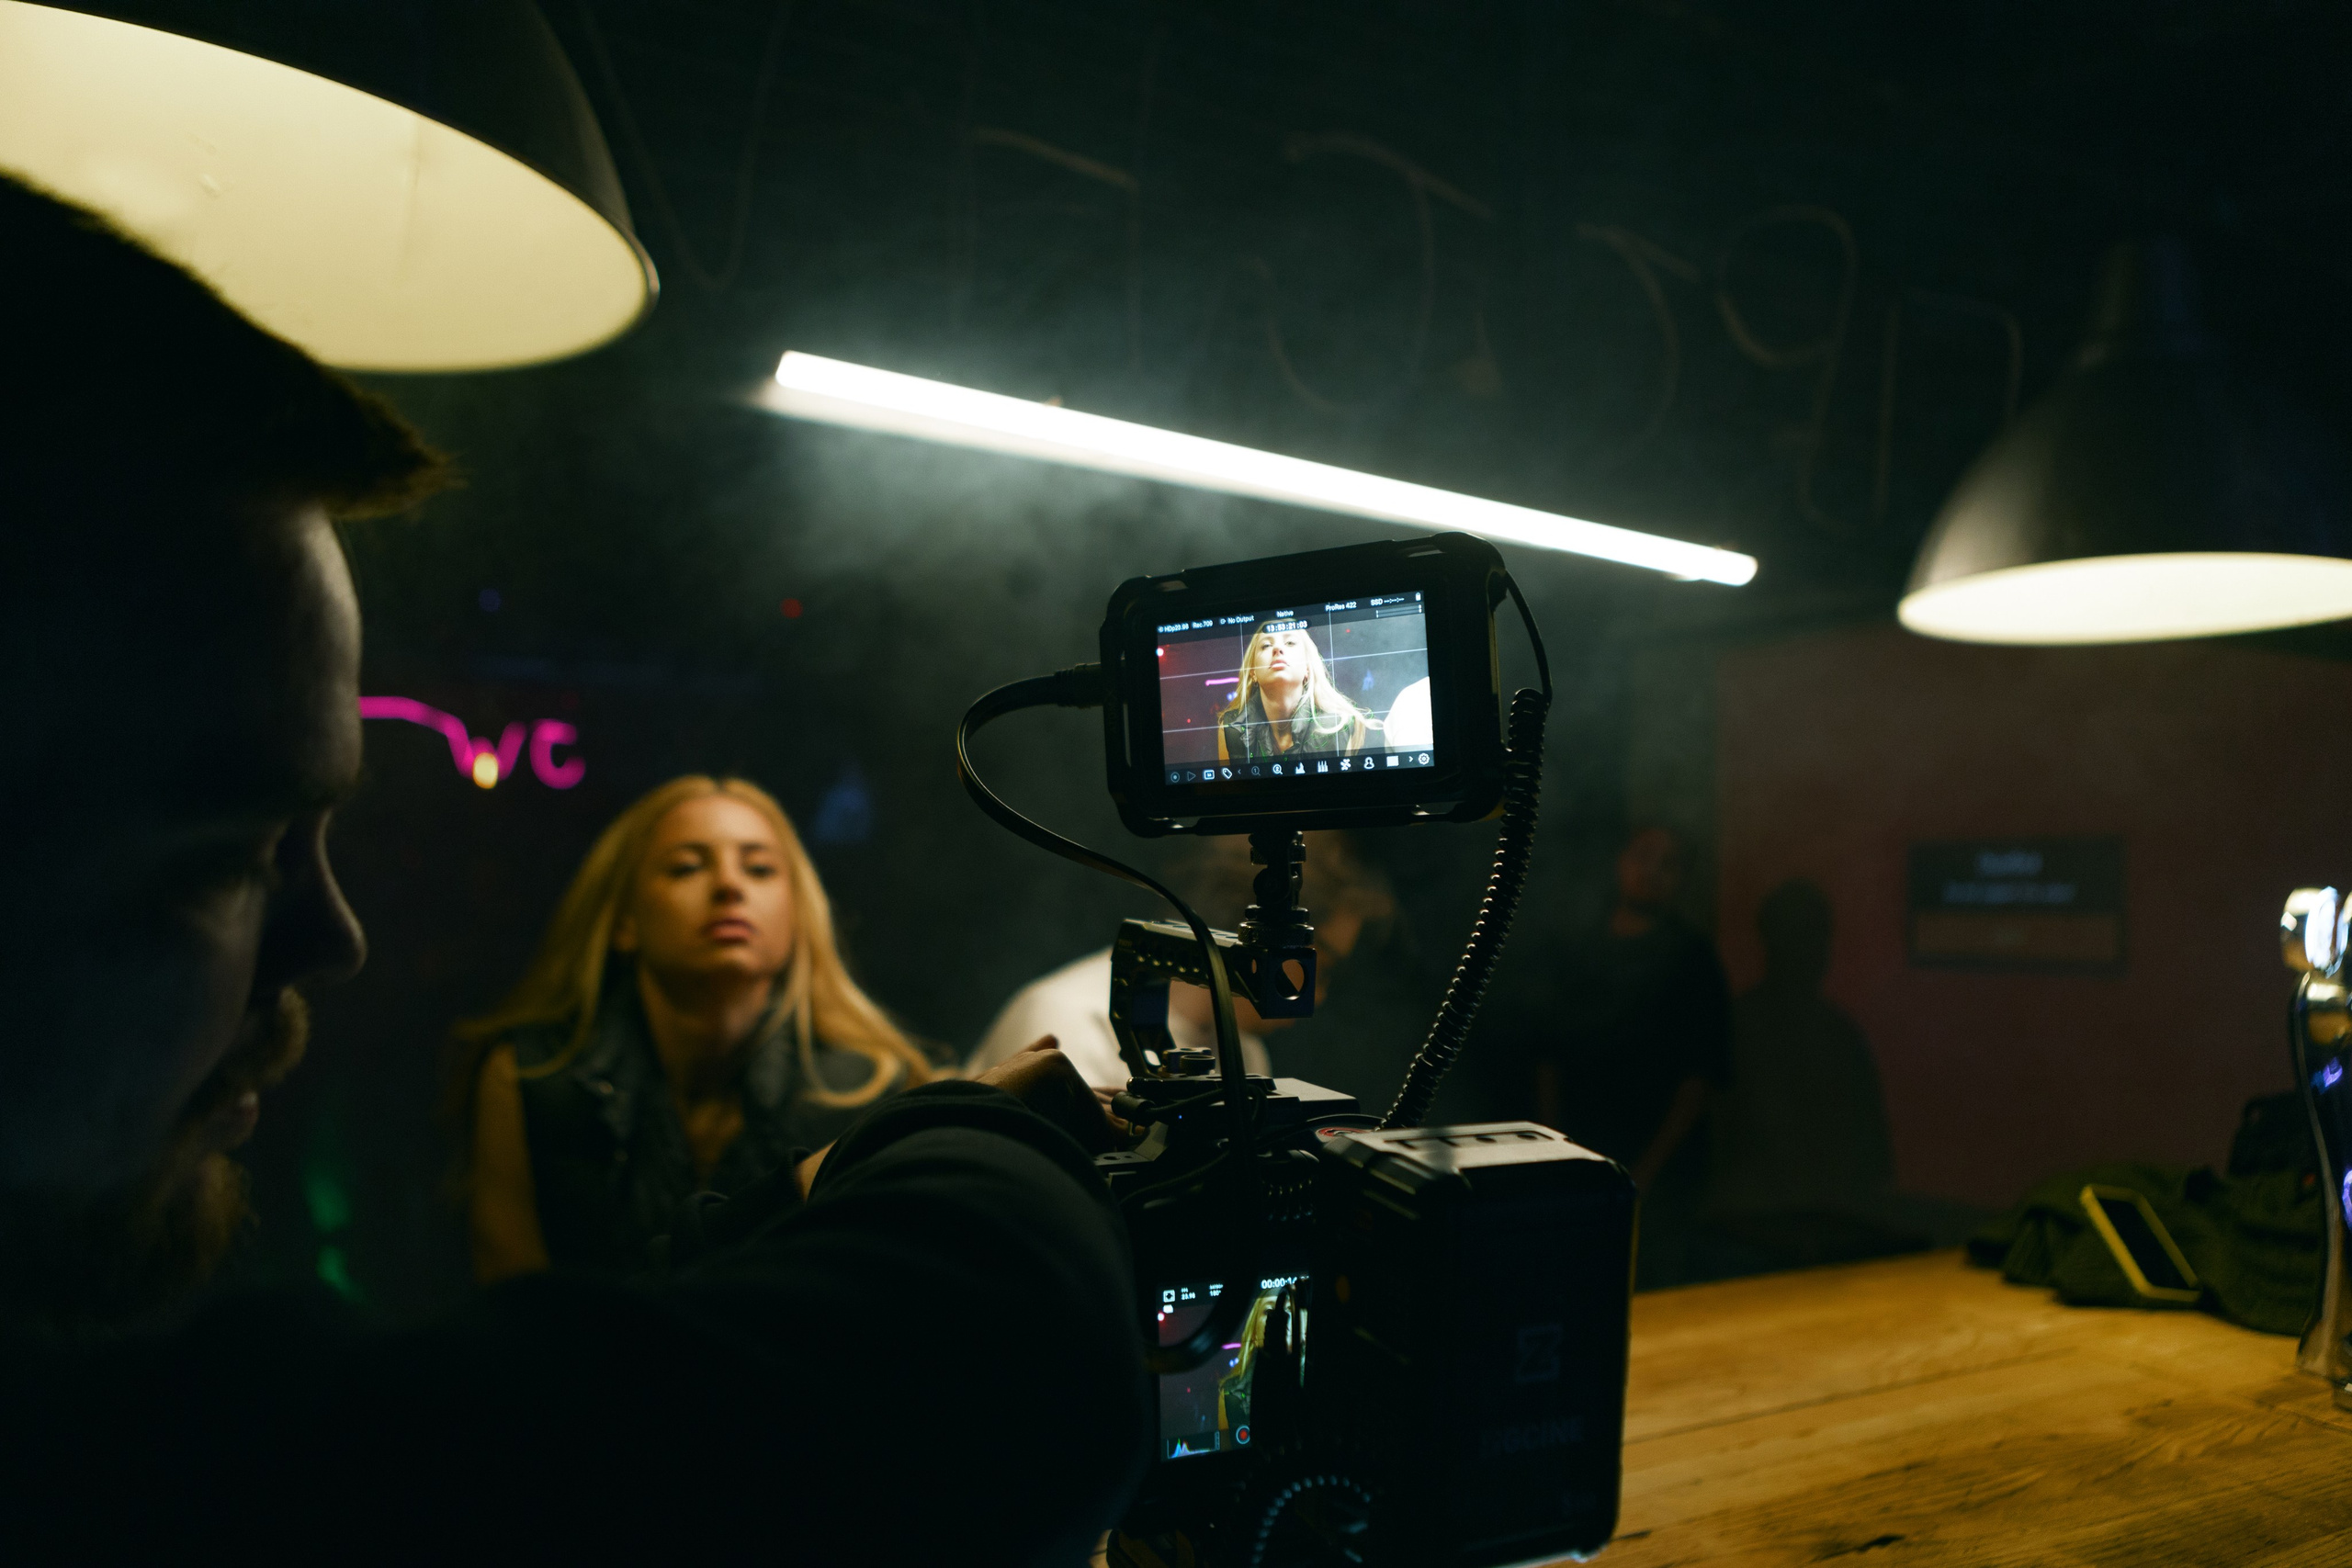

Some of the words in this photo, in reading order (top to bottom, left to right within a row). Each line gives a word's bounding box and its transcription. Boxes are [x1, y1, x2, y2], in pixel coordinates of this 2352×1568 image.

[1326, 603, 1344, 612] ProRes
[1346, 601, 1357, 610] 422
[1371, 598, 1383, 606] SSD
[1276, 610, 1294, 618] Native
[1227, 616, 1236, 625] No
[1236, 615, 1254, 625] Output
